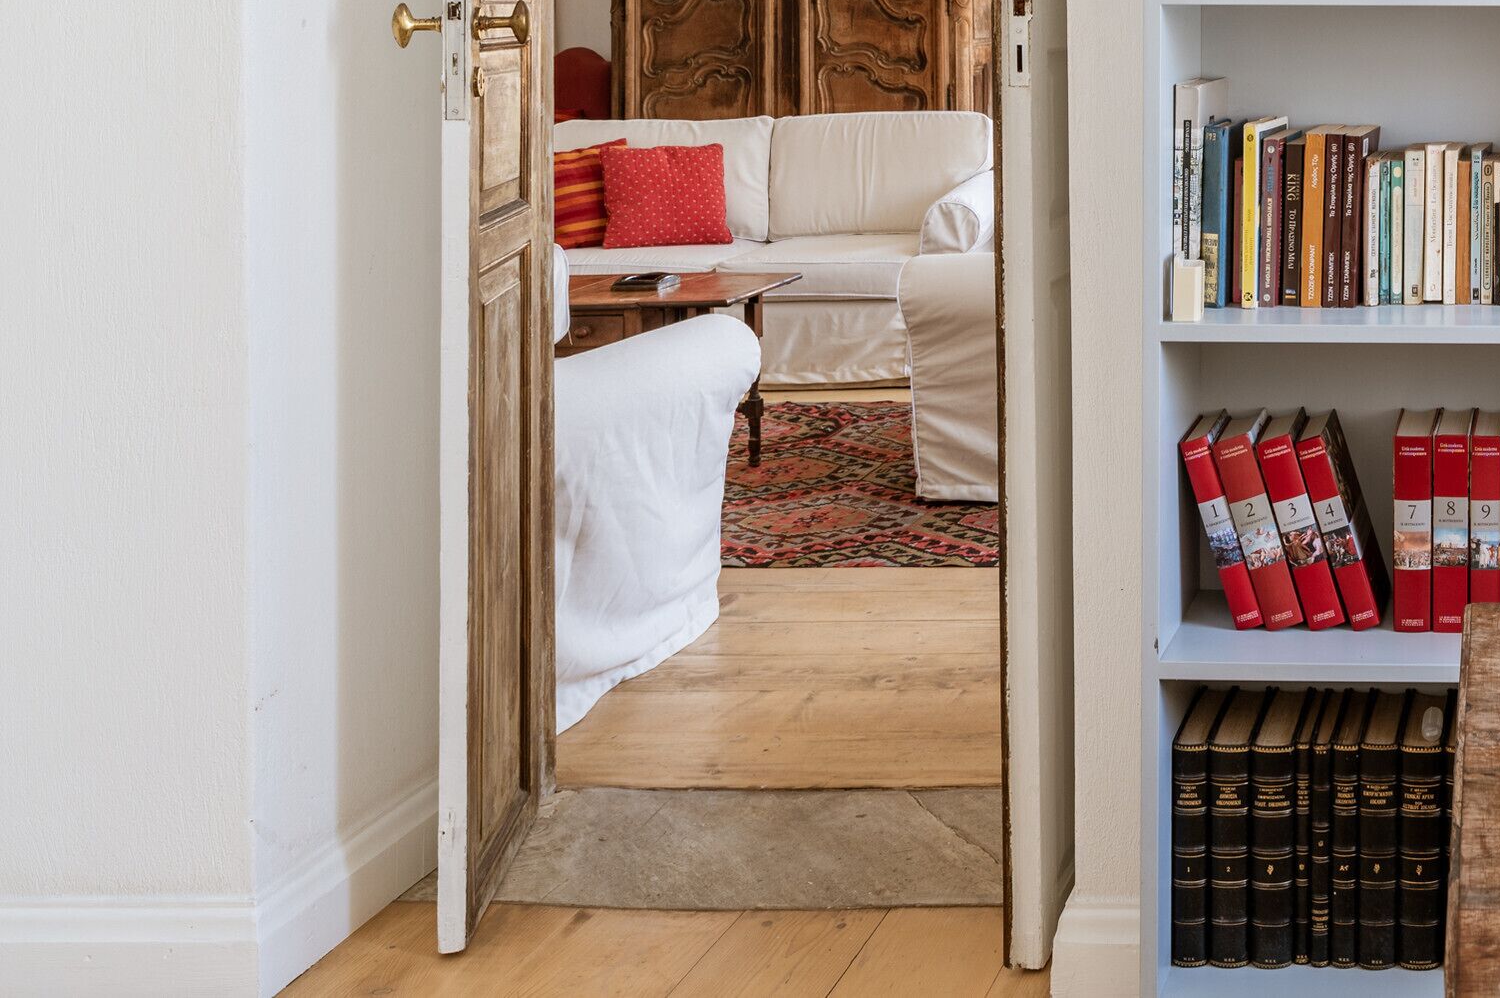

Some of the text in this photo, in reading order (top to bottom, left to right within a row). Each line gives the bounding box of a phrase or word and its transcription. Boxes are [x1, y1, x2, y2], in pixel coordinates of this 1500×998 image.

[1329, 154, 1338, 173] Οργής
[1346, 153, 1355, 172] Οργής
[1286, 173, 1296, 202] KING
[1328, 183, 1338, 210] Σταφύλια
[1345, 183, 1354, 209] Σταφύλια
[1329, 209, 1336, 218] Τα
[1345, 208, 1352, 217] Τα
[1287, 208, 1297, 270] ΤΟ ΠΡΑΣΙΝΟ ΜΙΛΙ
[1264, 263, 1272, 289] ΙΣΤΟΡΙΑ
[1308, 243, 1317, 301] ΤΖΟΖΕΦ ΚΟΝΡΑΝΤ
[1210, 503, 1220, 519] 1
[1244, 502, 1256, 518] 2
[1287, 502, 1297, 518] 3
[1324, 502, 1335, 517] 4
[1407, 504, 1417, 520] 7
[1446, 500, 1456, 516] 8
[1481, 504, 1491, 519] 9
